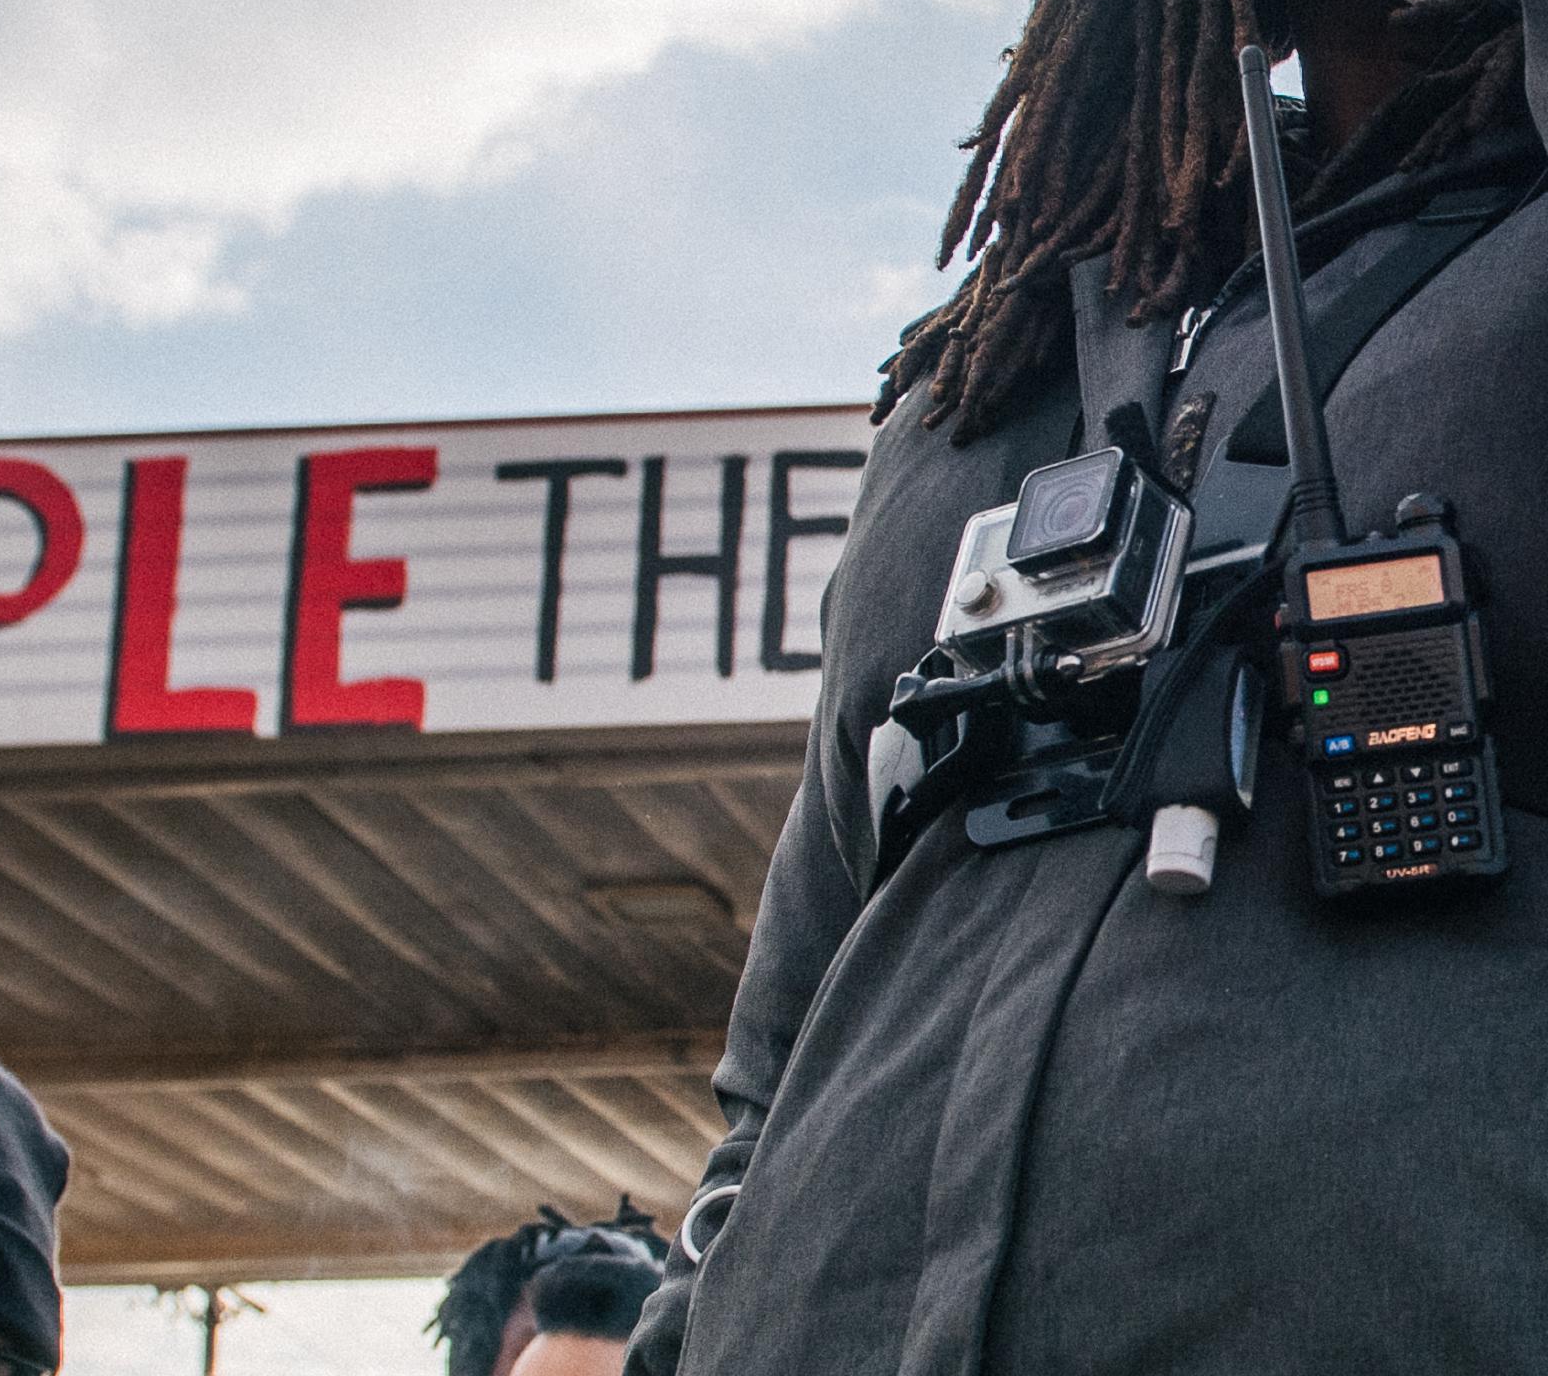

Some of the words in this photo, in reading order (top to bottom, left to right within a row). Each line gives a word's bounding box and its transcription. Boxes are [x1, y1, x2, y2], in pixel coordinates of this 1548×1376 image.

[1329, 739, 1351, 752] A/B
[1368, 723, 1437, 747] BAOFENG
[1369, 797, 1379, 809] 2
[1407, 792, 1416, 804] 3
[1334, 802, 1342, 814] 1
[1372, 821, 1382, 833] 5
[1409, 816, 1419, 827] 6
[1336, 827, 1346, 838] 4
[1375, 846, 1384, 858] 8
[1413, 840, 1423, 852] 9
[1339, 850, 1348, 862] 7
[1385, 864, 1431, 879] UV-5R
